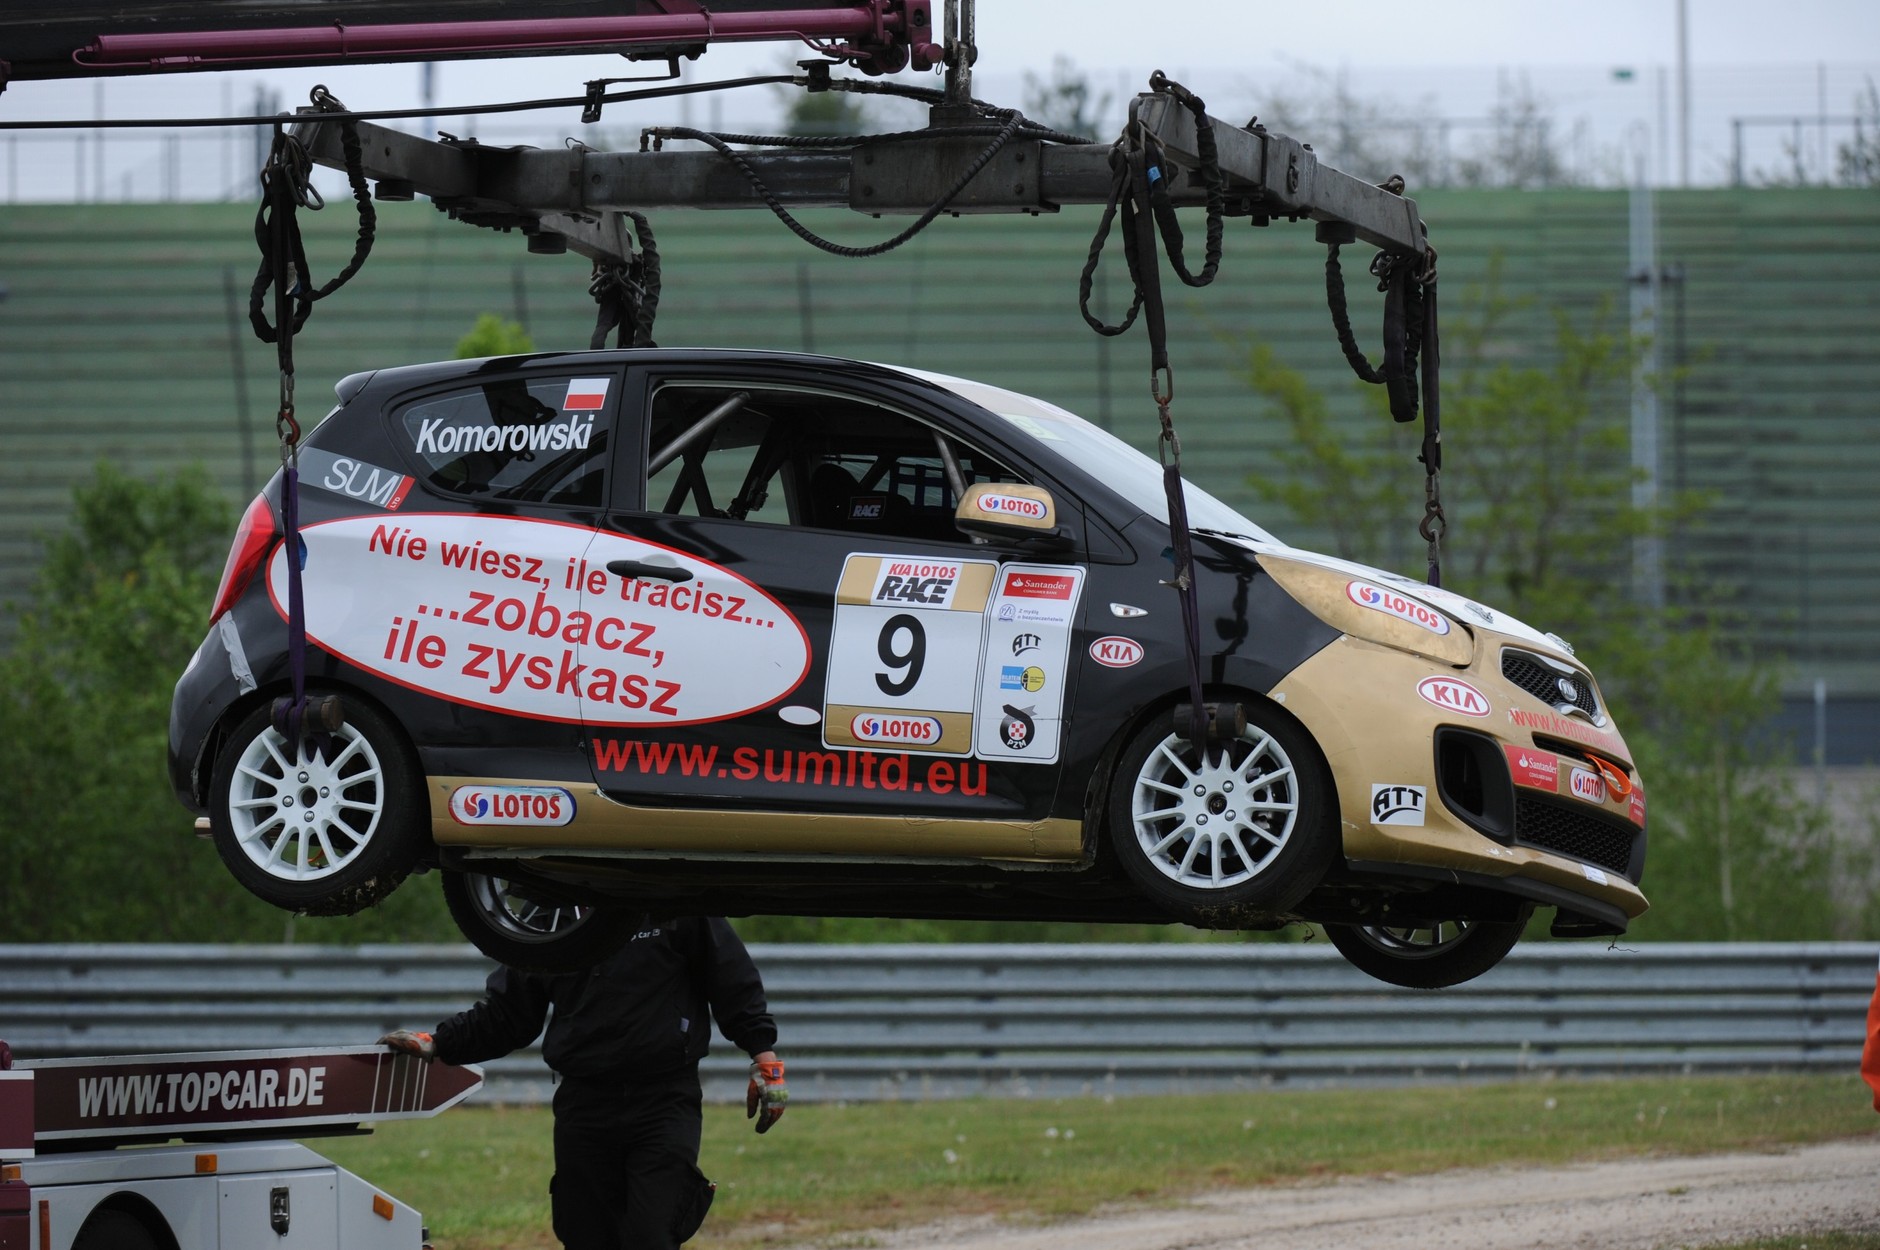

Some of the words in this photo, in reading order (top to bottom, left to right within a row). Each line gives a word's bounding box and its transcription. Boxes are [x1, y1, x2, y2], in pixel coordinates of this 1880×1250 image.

[415, 414, 595, 453] Komorowski
[324, 458, 400, 506] SUM
[390, 496, 401, 509] LTD
[852, 504, 881, 517] RACE
[1001, 498, 1039, 516] LOTOS
[369, 524, 428, 562] Nie
[440, 540, 551, 590] wiesz,
[564, 557, 608, 596] ile
[620, 574, 776, 629] tracisz...
[888, 563, 912, 576] KIA
[914, 565, 957, 579] LOTOS
[1024, 579, 1068, 590] Santander
[876, 575, 953, 604] RACE
[1383, 593, 1439, 629] LOTOS
[417, 591, 666, 669] ...zobacz,
[1012, 633, 1042, 653] ATT
[875, 614, 927, 697] 9
[1099, 643, 1134, 661] KIA
[383, 616, 447, 669] ile
[461, 642, 683, 717] zyskasz
[1431, 683, 1482, 712] KIA
[882, 719, 931, 739] LOTOS
[1007, 739, 1027, 749] PZM
[592, 738, 988, 797] www.sumltd.eu
[1528, 757, 1557, 774] Santander
[1582, 776, 1603, 799] LOTOS
[493, 794, 561, 820] LOTOS
[1373, 787, 1423, 817] ATT
[78, 1066, 327, 1118] WWW.TOPCAR.DE
